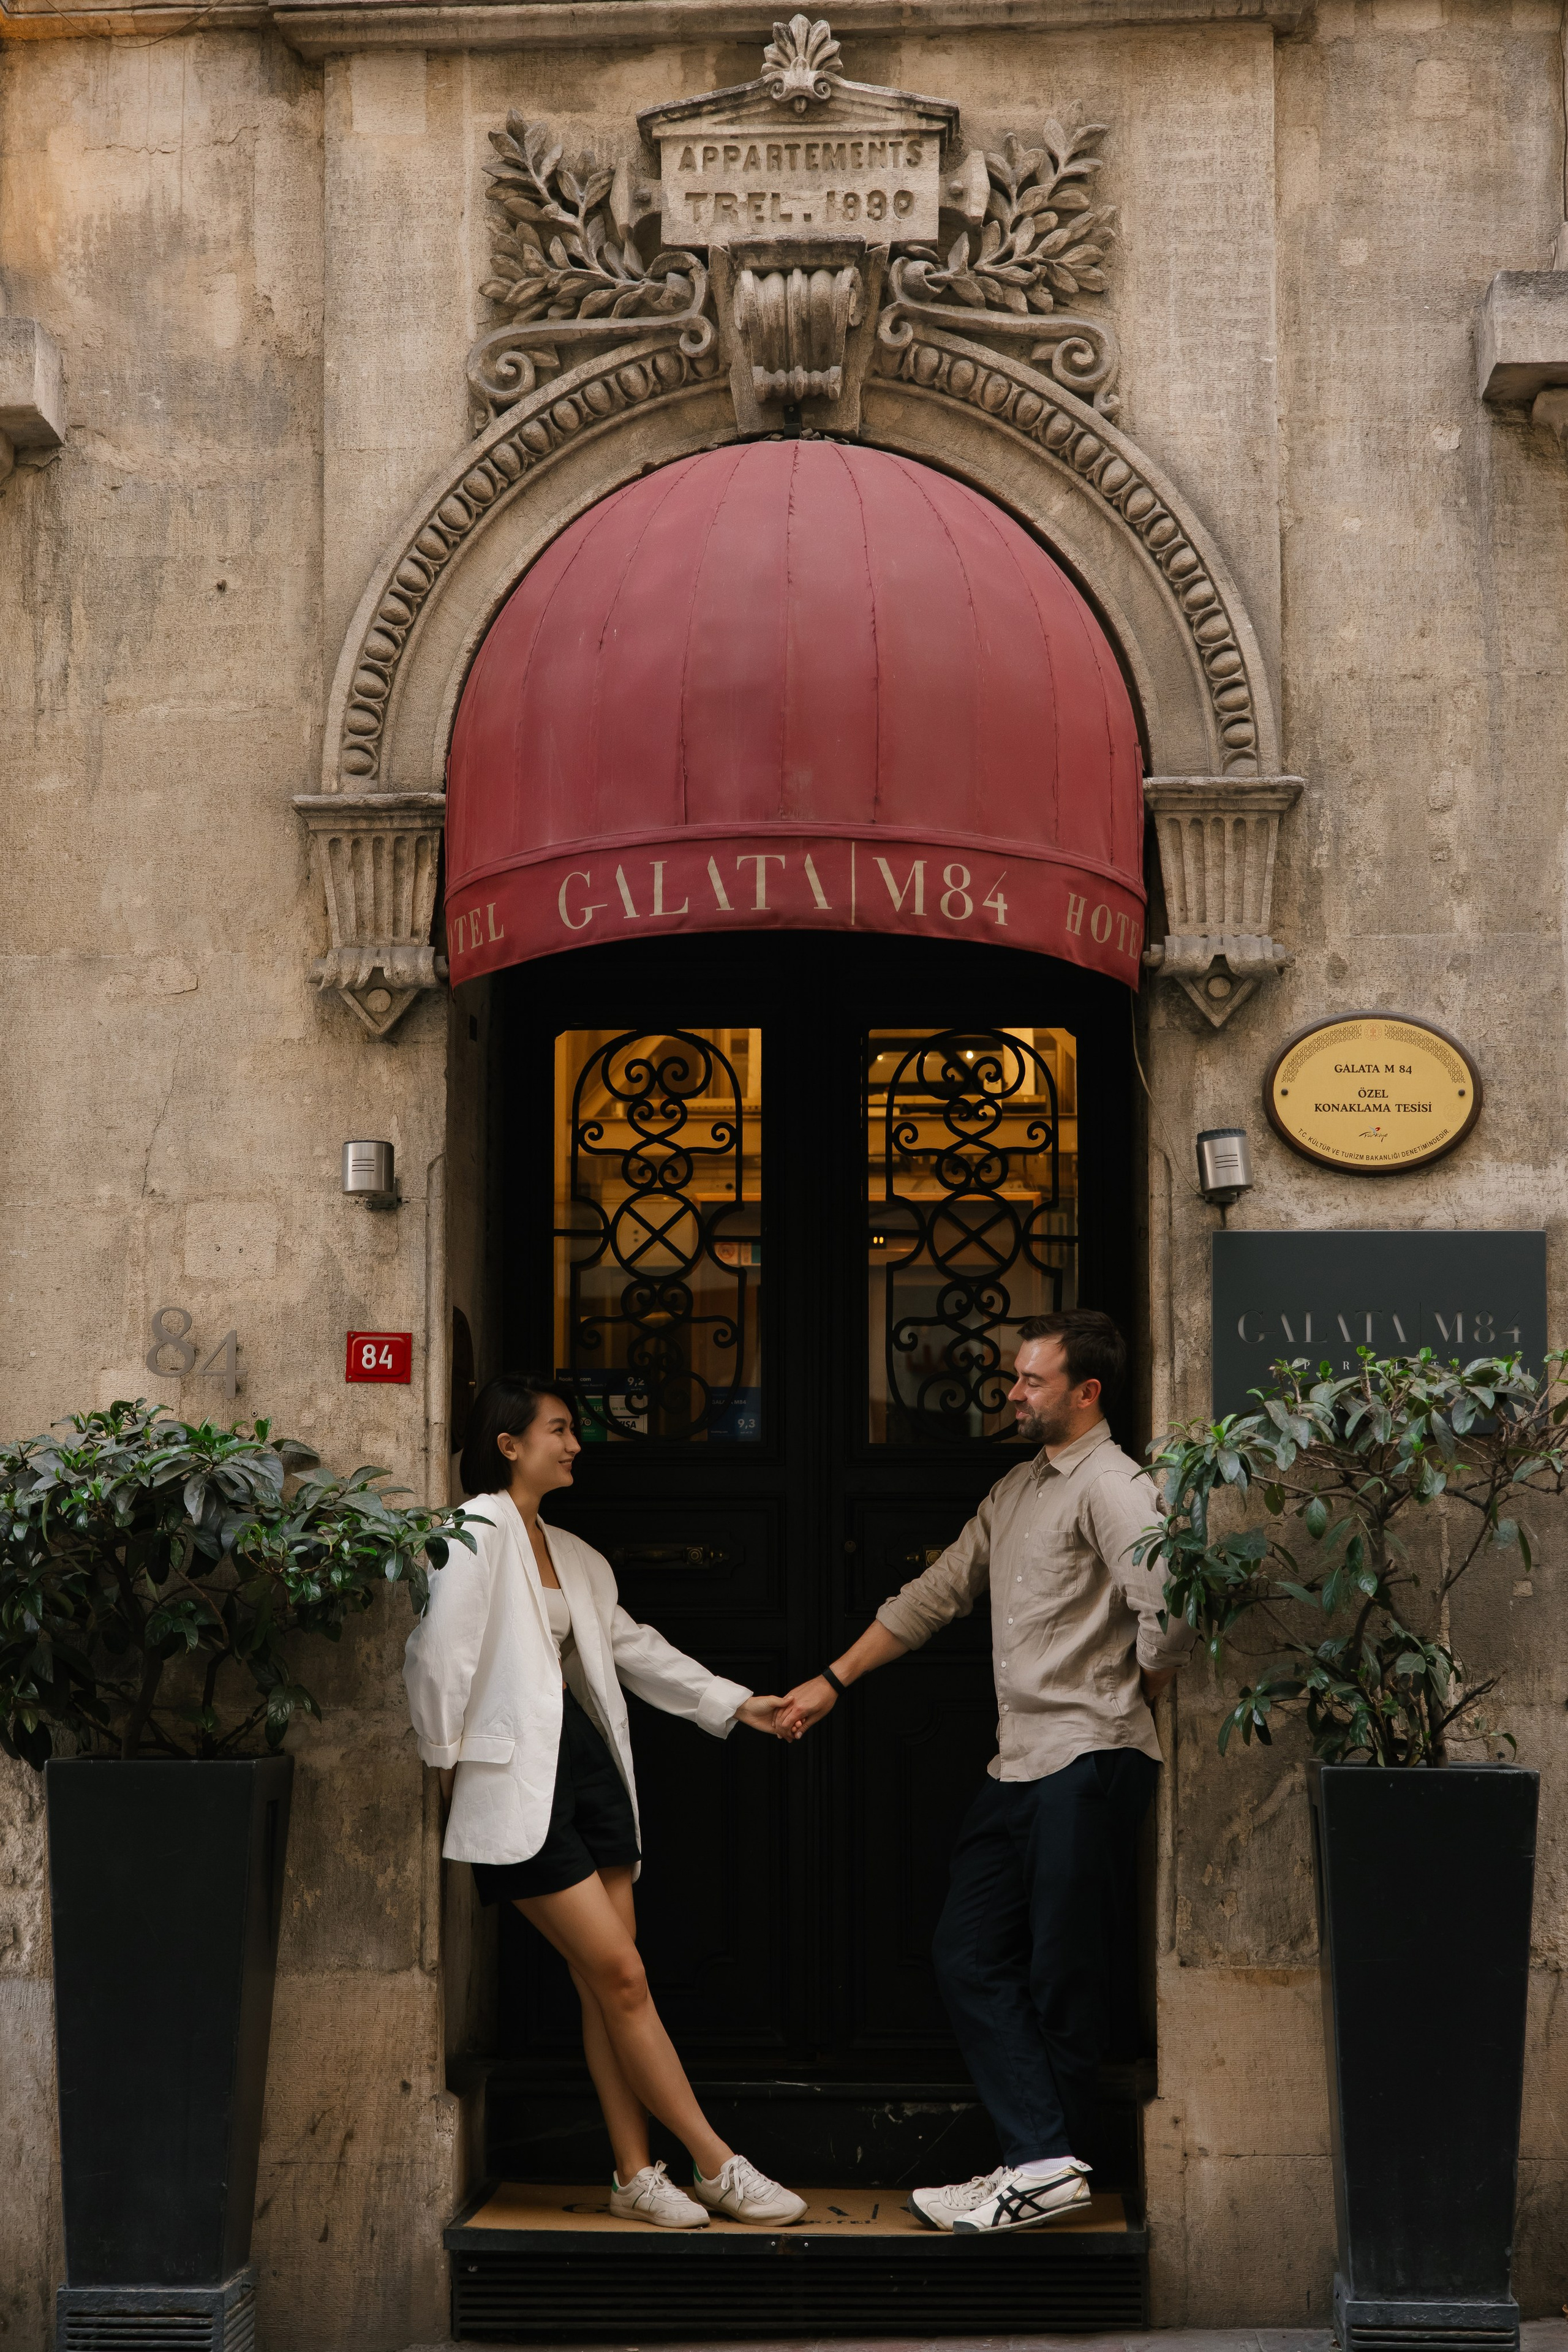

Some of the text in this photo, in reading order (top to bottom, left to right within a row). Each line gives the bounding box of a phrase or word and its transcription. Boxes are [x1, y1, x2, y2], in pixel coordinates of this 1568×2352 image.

[677, 139, 924, 172] APPARTEMENTS
[826, 190, 914, 222] 1890
[558, 853, 832, 930] GALATA
[872, 858, 1008, 926] M84
[1334, 1064, 1412, 1074] GALATA M 84
[1314, 1101, 1432, 1113] KONAKLAMA TESİSİ
[1358, 1087, 1389, 1098] ÖZEL
[1298, 1128, 1306, 1138] T.C.
[1308, 1136, 1330, 1153] KÜLTÜR
[1341, 1152, 1364, 1160] TURİZM
[1237, 1309, 1521, 1343] GALATA M84
[146, 1306, 246, 1400] 84
[361, 1344, 393, 1370] 84
[737, 1419, 755, 1429] 9,3
